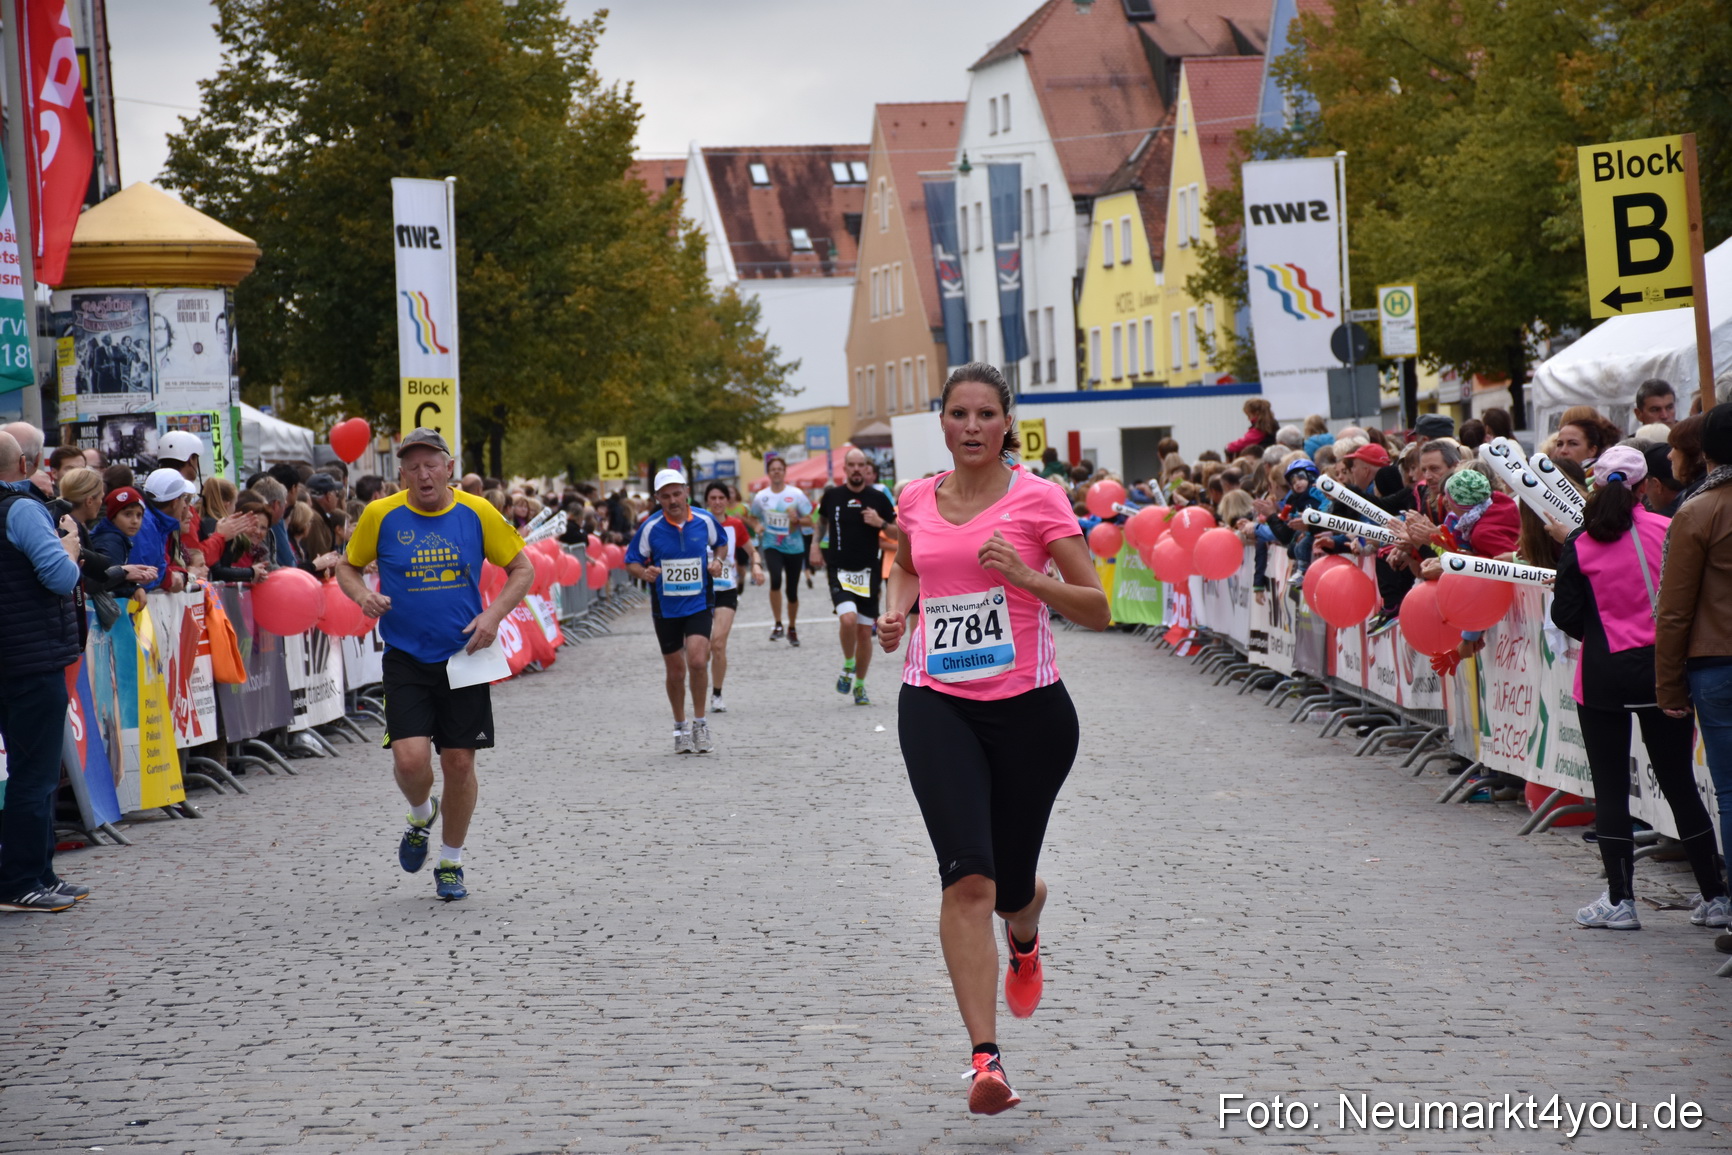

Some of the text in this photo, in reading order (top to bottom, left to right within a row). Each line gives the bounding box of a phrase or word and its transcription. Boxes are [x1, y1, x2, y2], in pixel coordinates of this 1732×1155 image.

[1592, 143, 1685, 182] Block
[1612, 191, 1675, 277] B
[407, 380, 449, 396] Block
[414, 401, 441, 431] C
[1026, 431, 1042, 451] D
[604, 450, 620, 471] D
[1327, 517, 1357, 532] BMW
[666, 567, 699, 582] 2269
[1474, 560, 1510, 575] BMW
[925, 604, 951, 614] PARTL
[933, 609, 1003, 650] 2784
[942, 653, 995, 670] Christina
